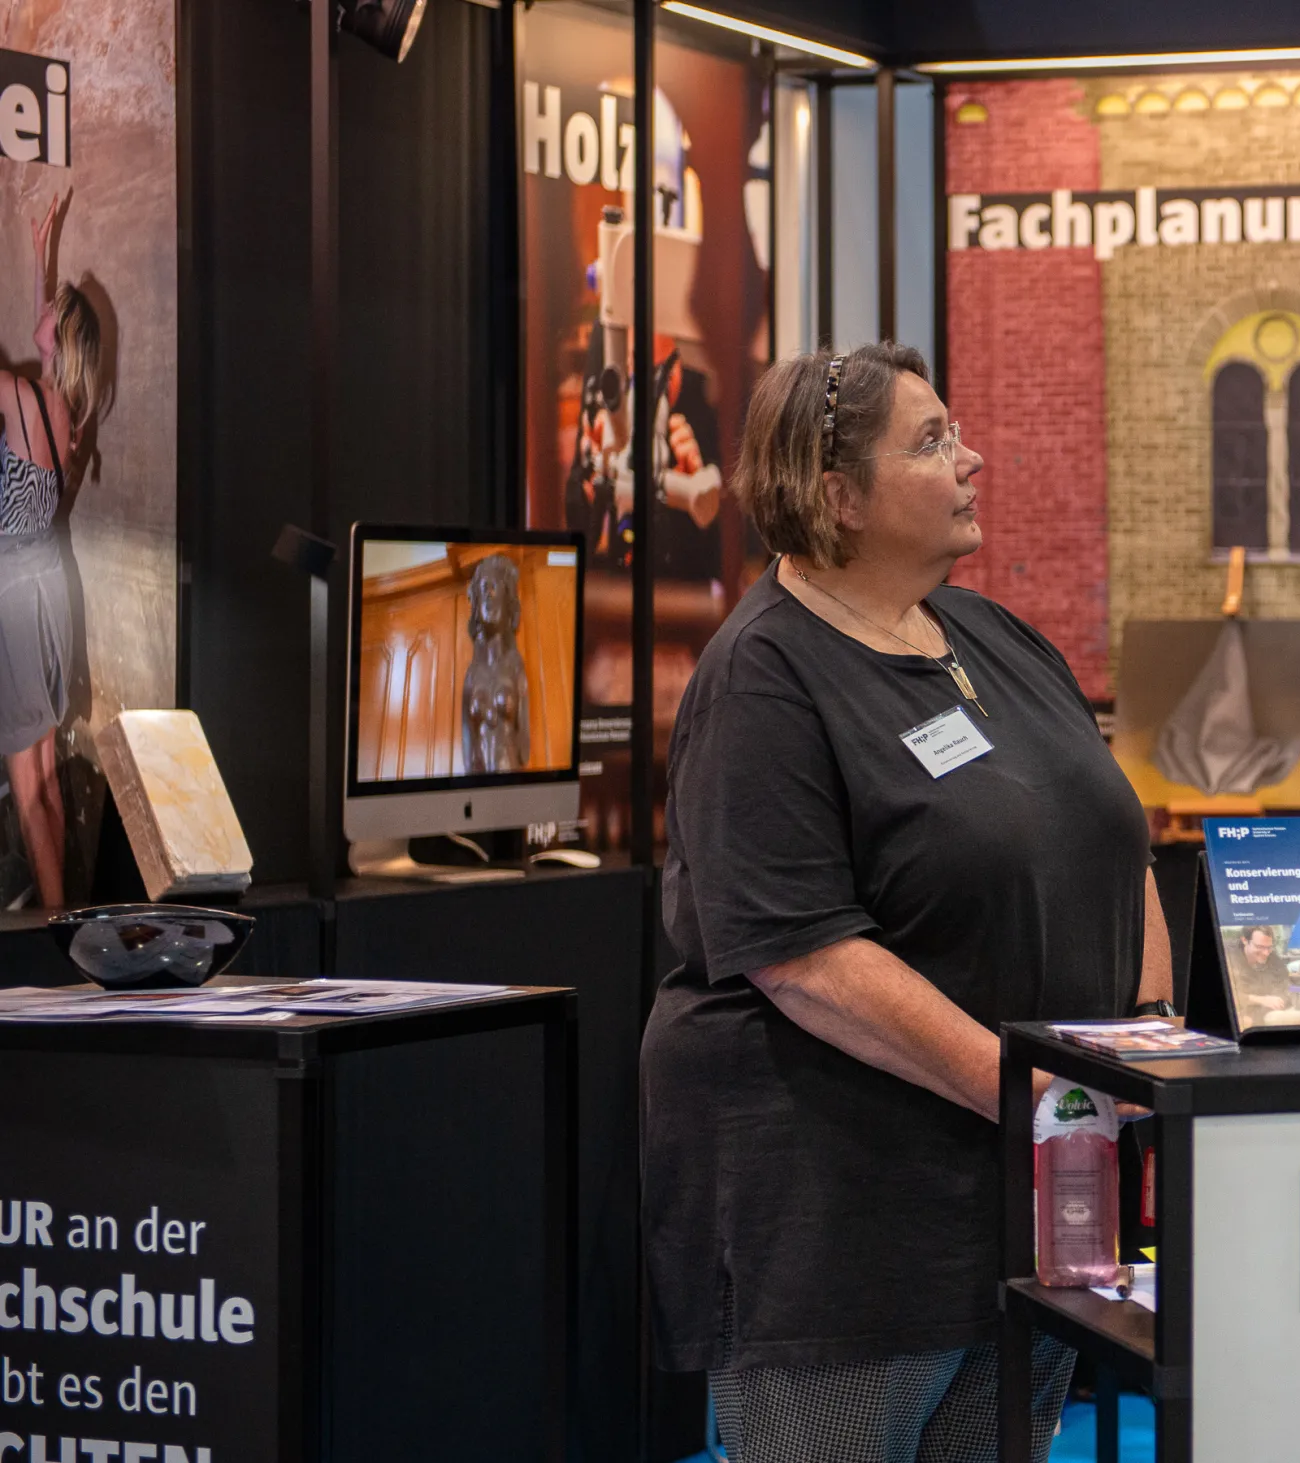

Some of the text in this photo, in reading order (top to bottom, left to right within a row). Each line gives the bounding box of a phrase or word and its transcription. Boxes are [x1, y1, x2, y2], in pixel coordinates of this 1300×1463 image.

[0, 64, 69, 165] ei
[1218, 827, 1250, 840] FH;P
[1228, 880, 1249, 891] und
[0, 1200, 206, 1255] UR an der
[0, 1267, 255, 1344] chschule
[3, 1356, 196, 1416] bt es den
